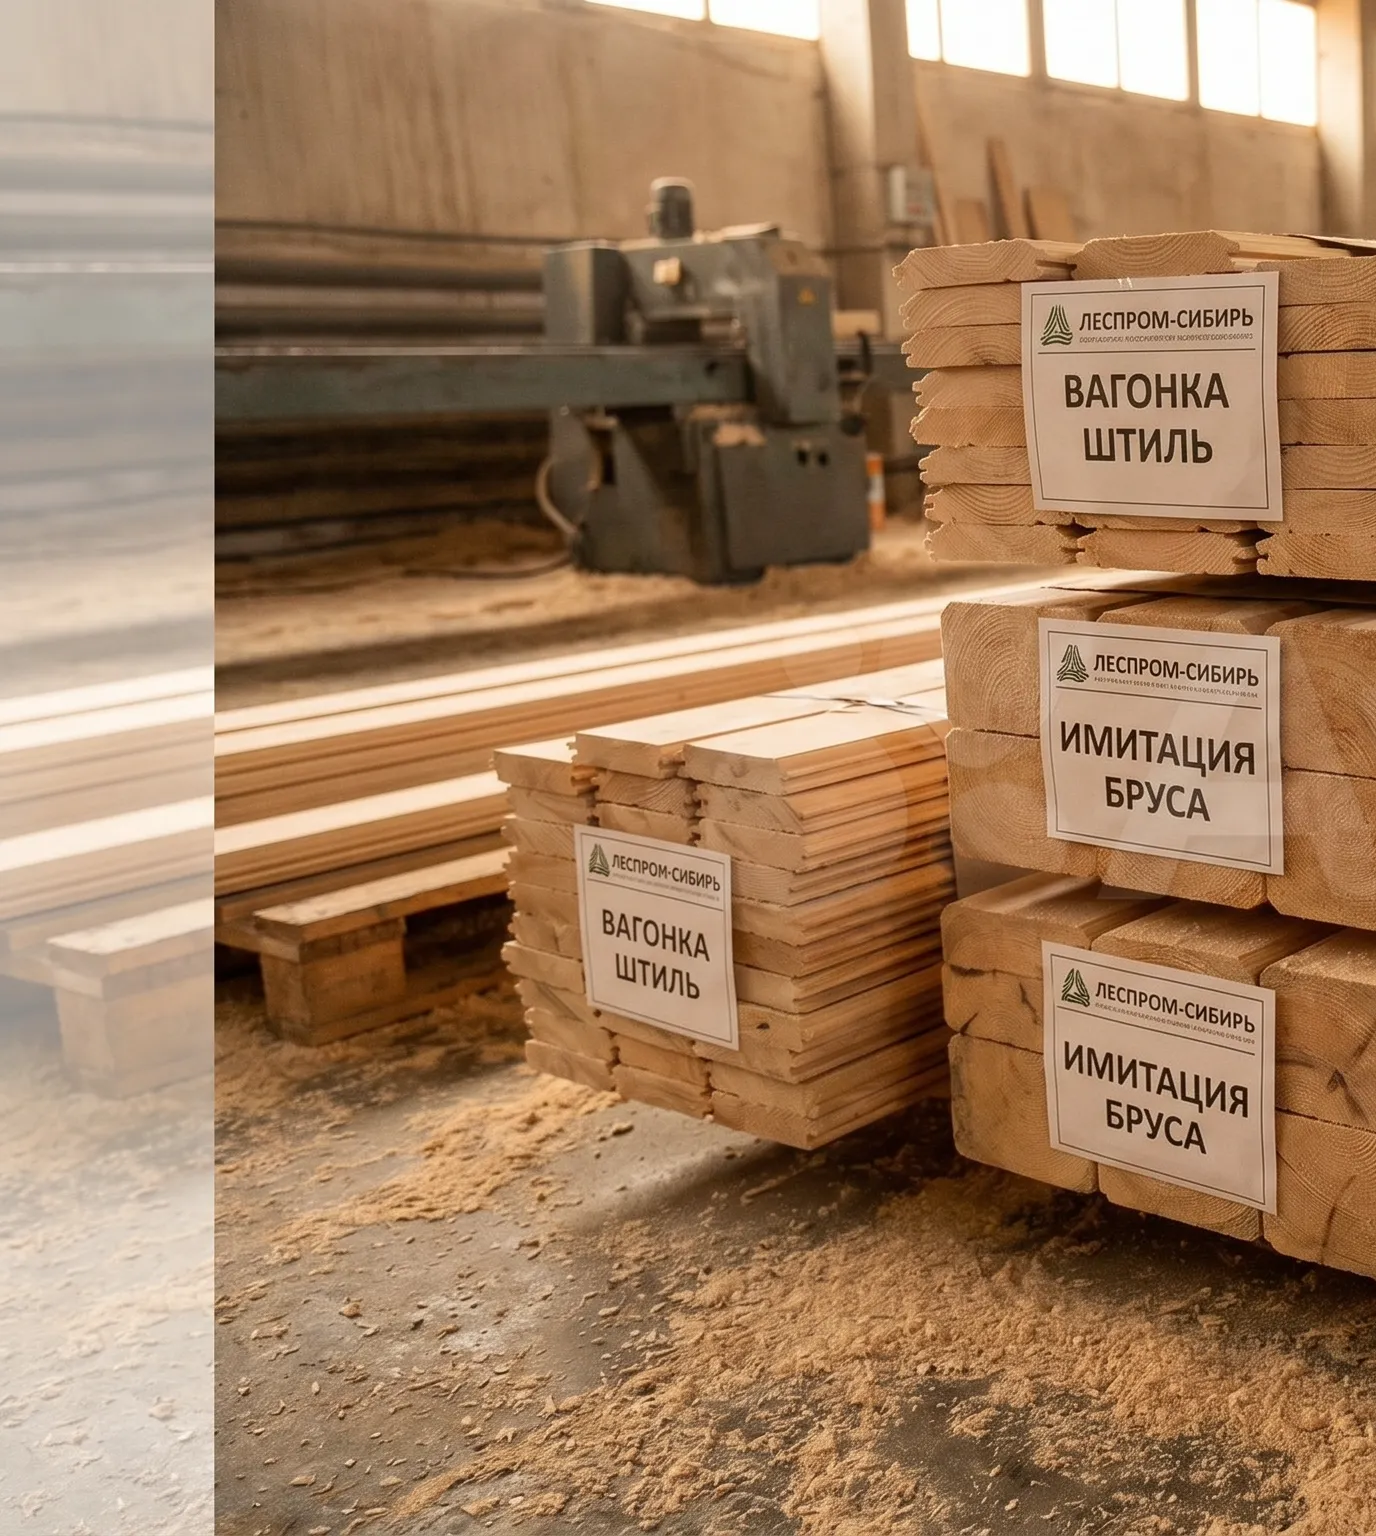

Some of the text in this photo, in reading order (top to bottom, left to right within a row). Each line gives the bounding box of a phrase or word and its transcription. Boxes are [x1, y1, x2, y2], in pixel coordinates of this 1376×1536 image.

[1079, 308, 1254, 331] ЛЕСПРОМ-СИБИРЬ
[1064, 373, 1230, 408] ВАГОНКА
[1083, 428, 1213, 463] ШТИЛЬ
[1093, 654, 1259, 687] ЛЕСПРОМ-СИБИРЬ
[1060, 721, 1255, 777] ИМИТАЦИЯ
[1105, 776, 1210, 822] БРУСА
[612, 854, 721, 892] ЛЕСПРОМ-СИБИРЬ
[602, 909, 710, 962] ВАГОНКА
[615, 953, 700, 1000] ШТИЛЬ
[1095, 981, 1255, 1033] ЛЕСПРОМ-СИБИРЬ
[1064, 1041, 1249, 1118] ИМИТАЦИЯ
[1106, 1098, 1207, 1155] БРУСА
